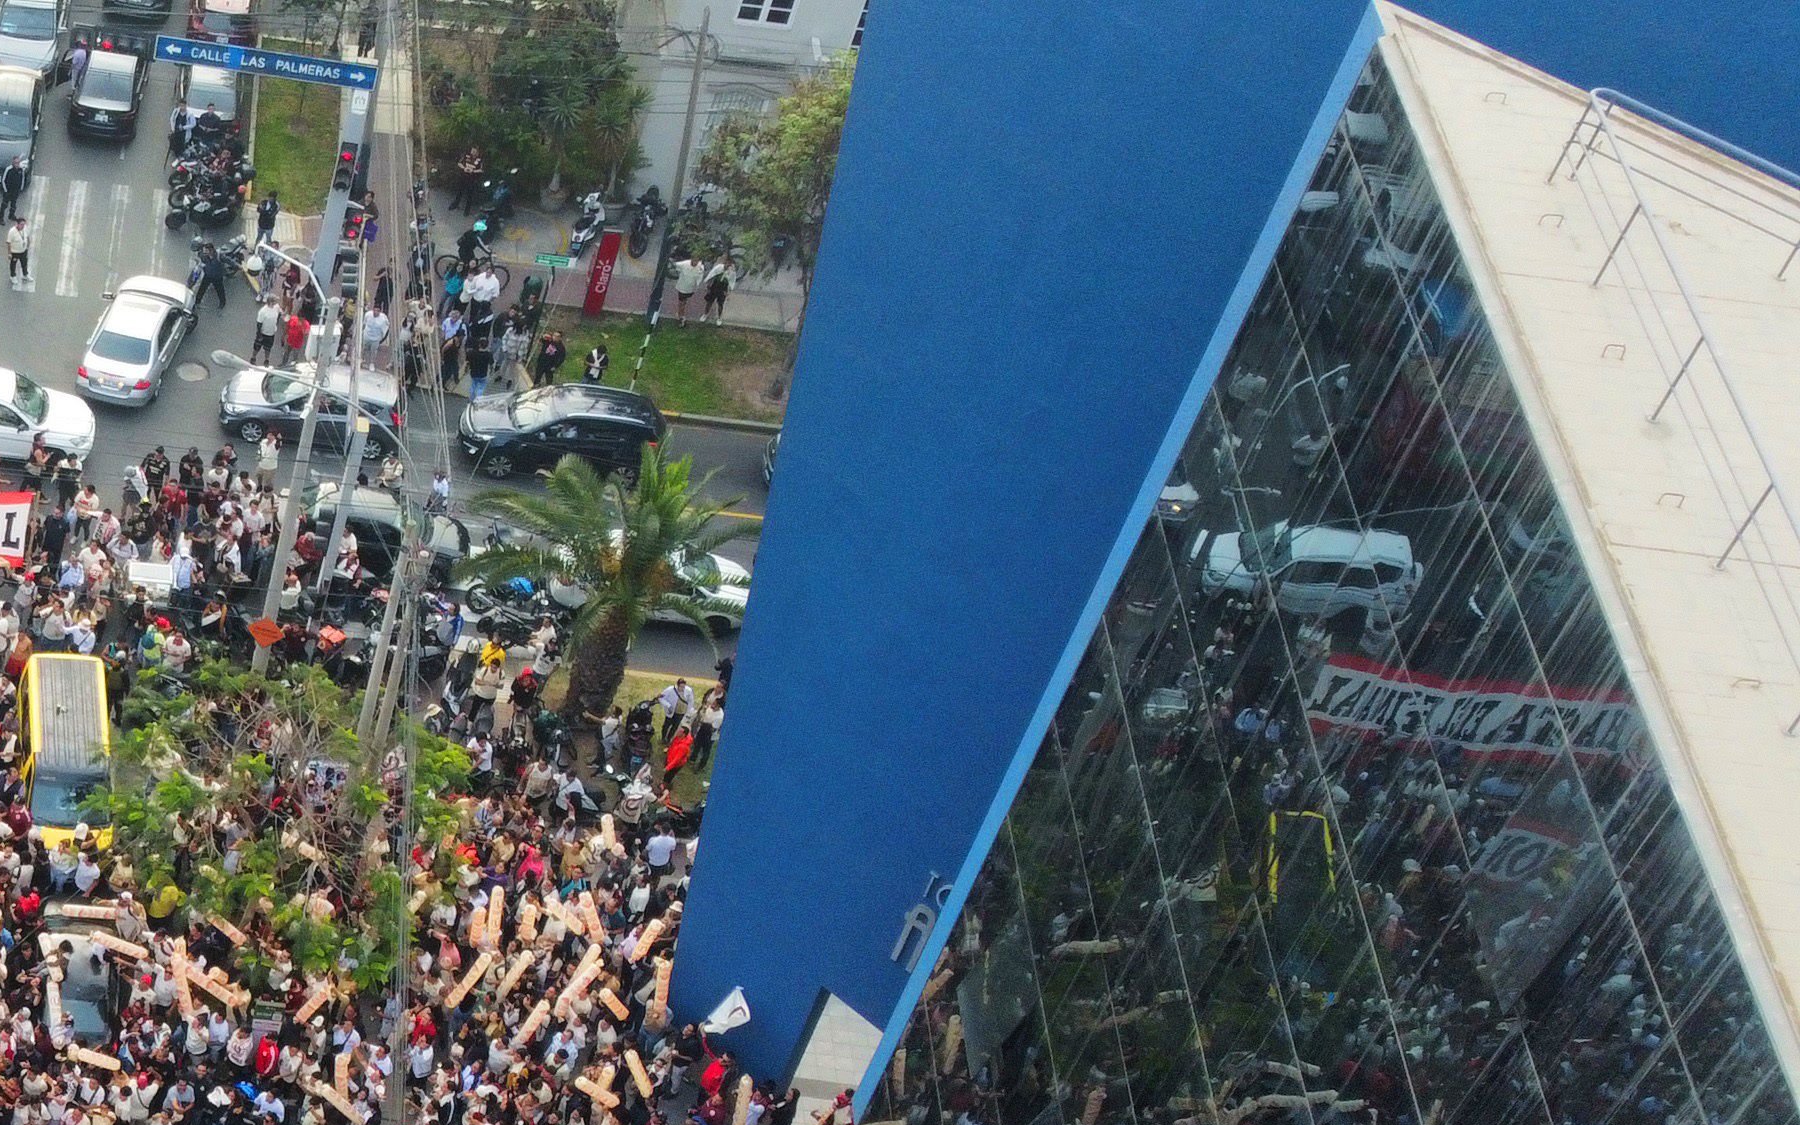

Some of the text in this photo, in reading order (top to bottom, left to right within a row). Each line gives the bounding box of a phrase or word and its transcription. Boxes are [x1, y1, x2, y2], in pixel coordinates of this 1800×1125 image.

[190, 47, 341, 79] CALLE LAS PALMERAS
[595, 262, 612, 293] Claro
